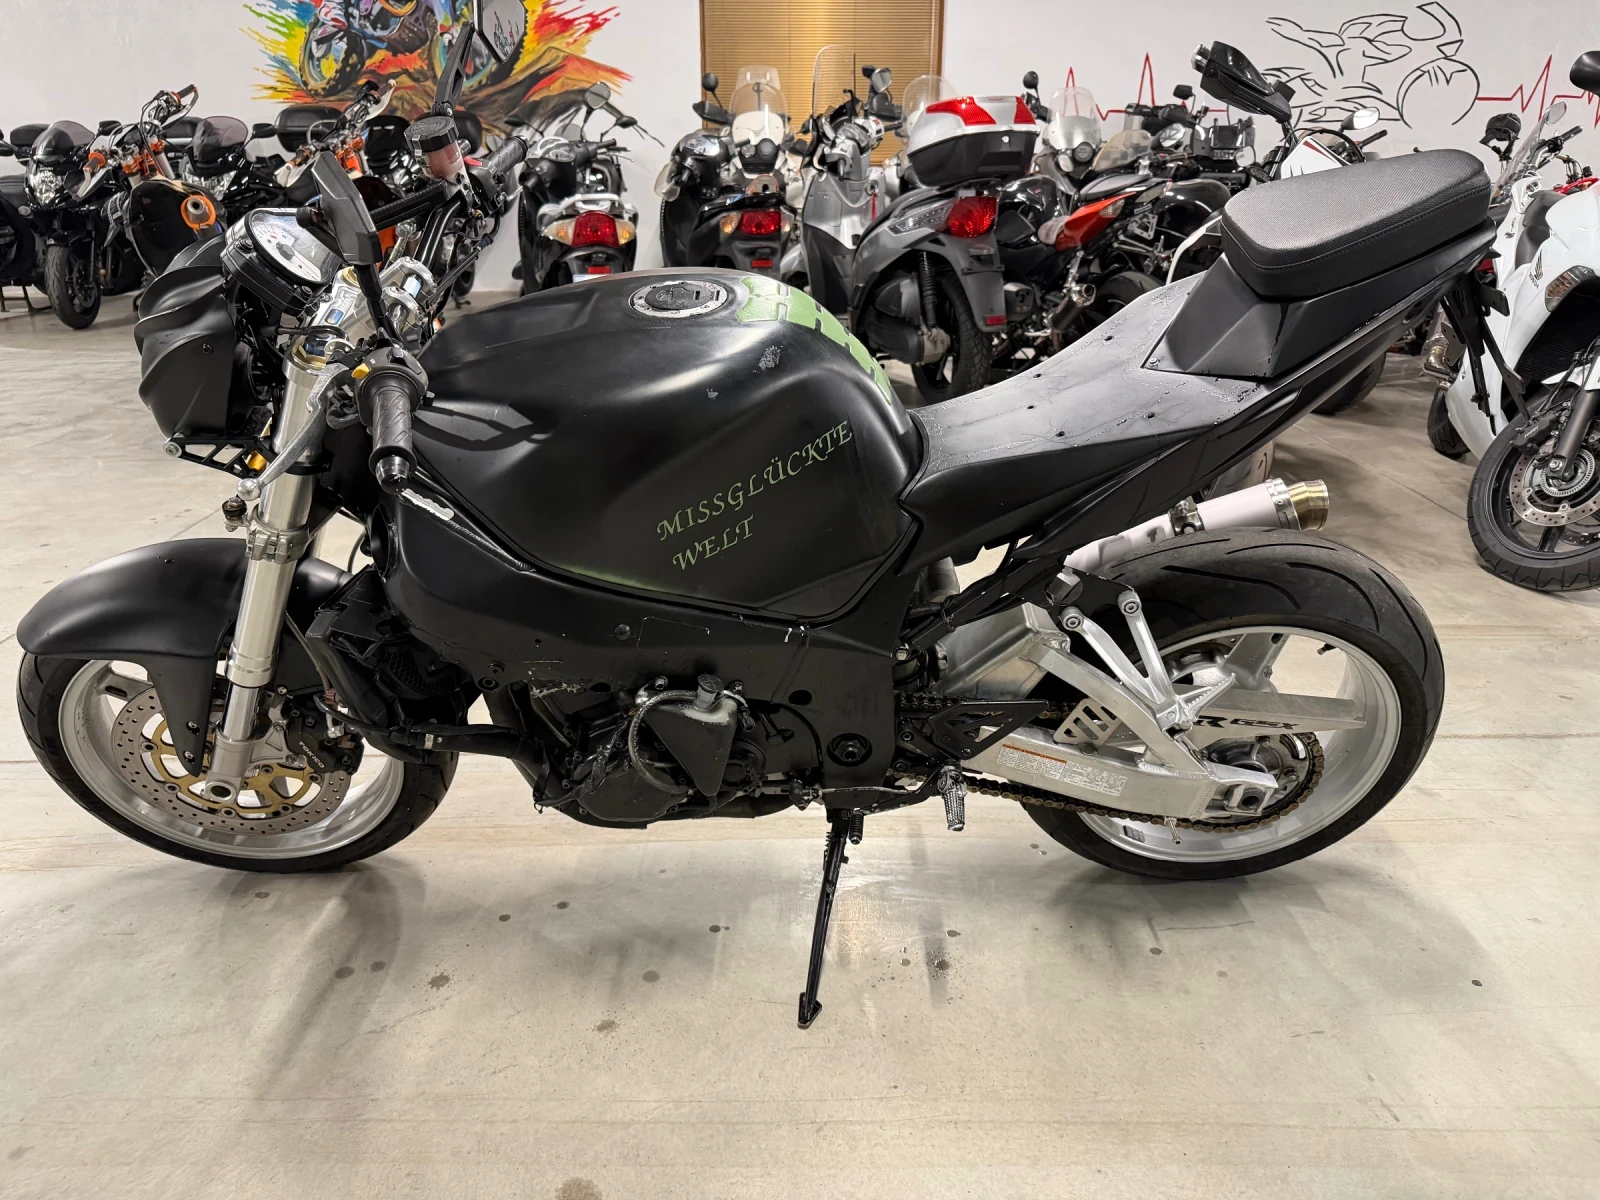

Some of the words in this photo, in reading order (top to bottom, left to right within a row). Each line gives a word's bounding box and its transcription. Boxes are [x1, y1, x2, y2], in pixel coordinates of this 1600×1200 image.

[656, 420, 853, 541] MISSGLÜCKTE
[672, 515, 754, 570] WELT
[298, 740, 325, 769] TOKICO
